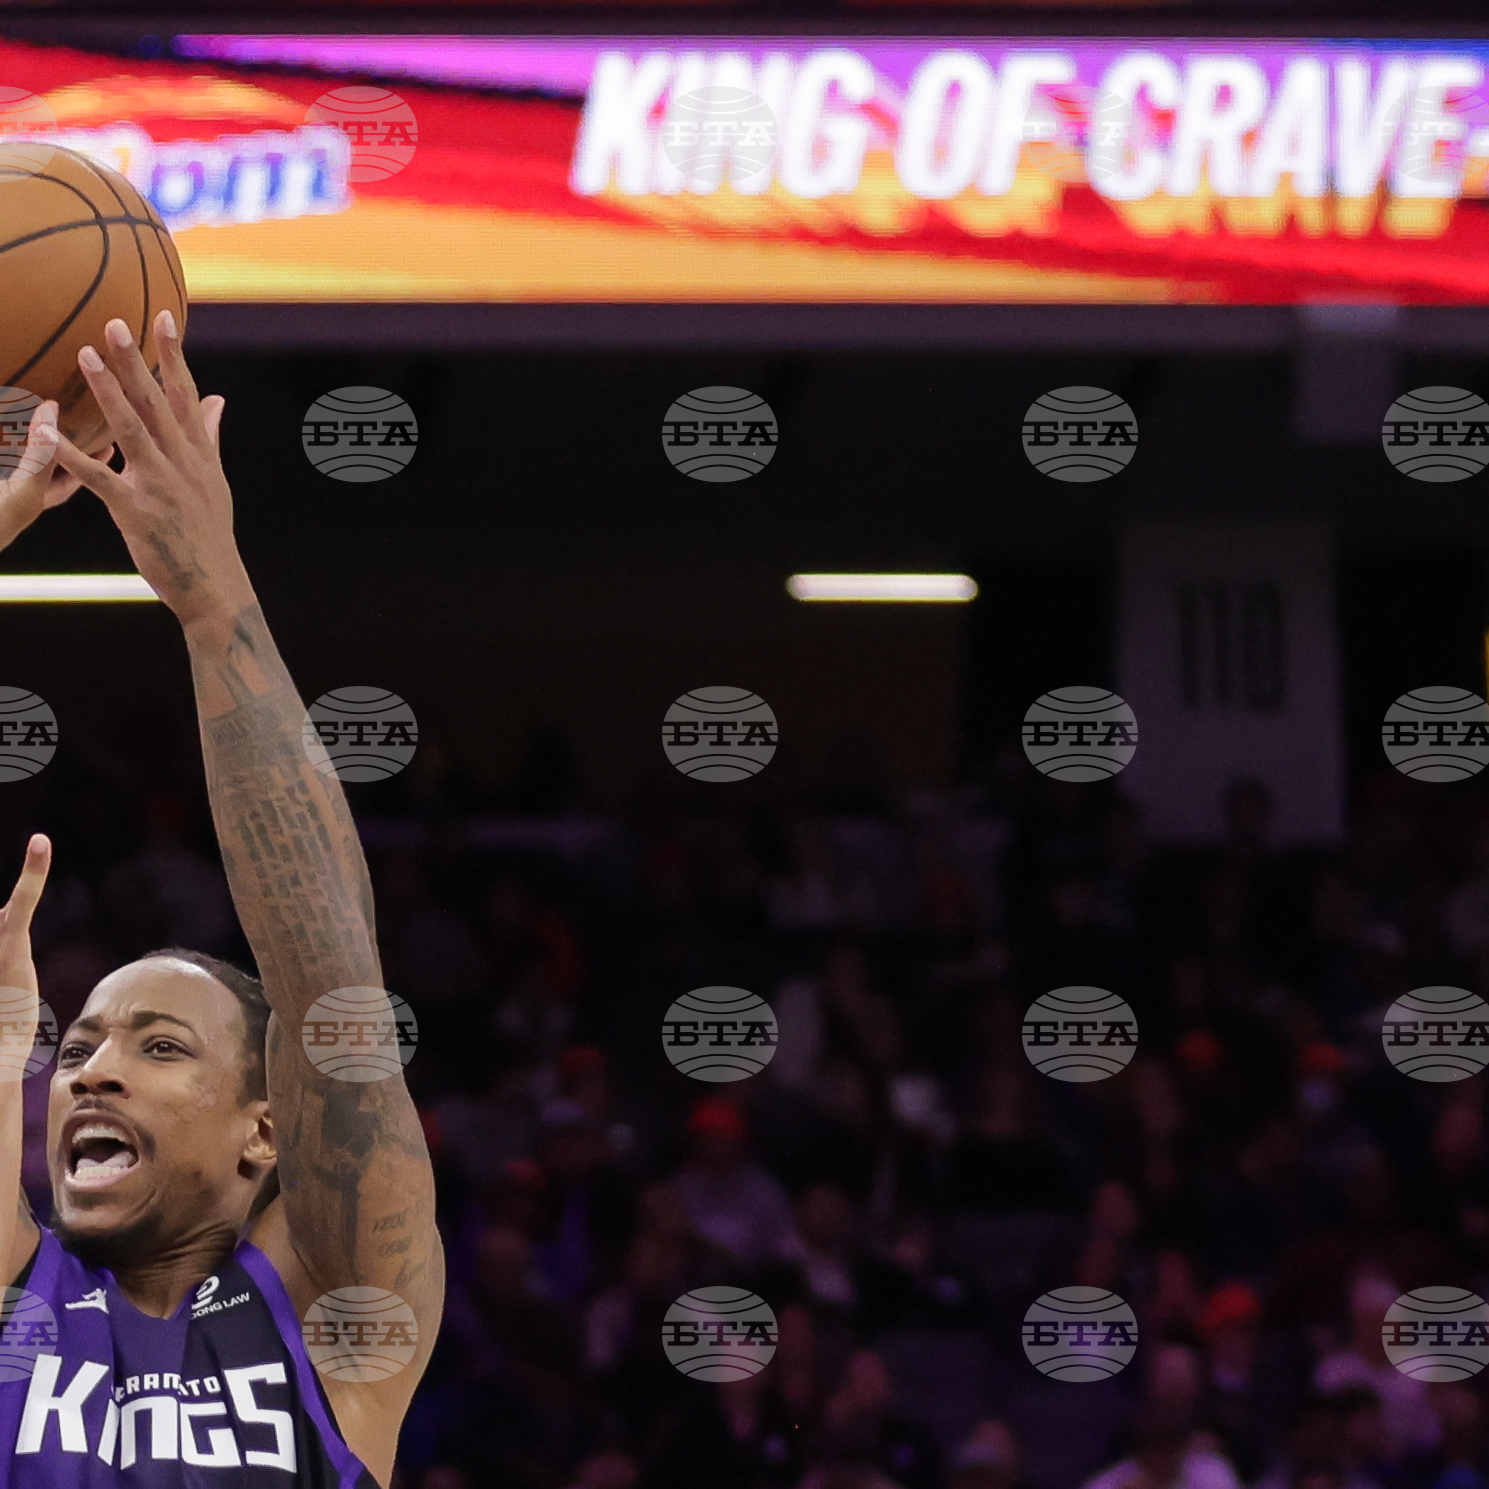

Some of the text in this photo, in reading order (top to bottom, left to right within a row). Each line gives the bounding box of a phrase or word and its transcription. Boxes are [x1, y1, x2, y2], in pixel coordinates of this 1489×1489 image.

[568, 46, 876, 197] KING
[894, 48, 1078, 197] OF
[224, 1292, 251, 1308] LAW
[15, 1354, 298, 1474] KINGS
